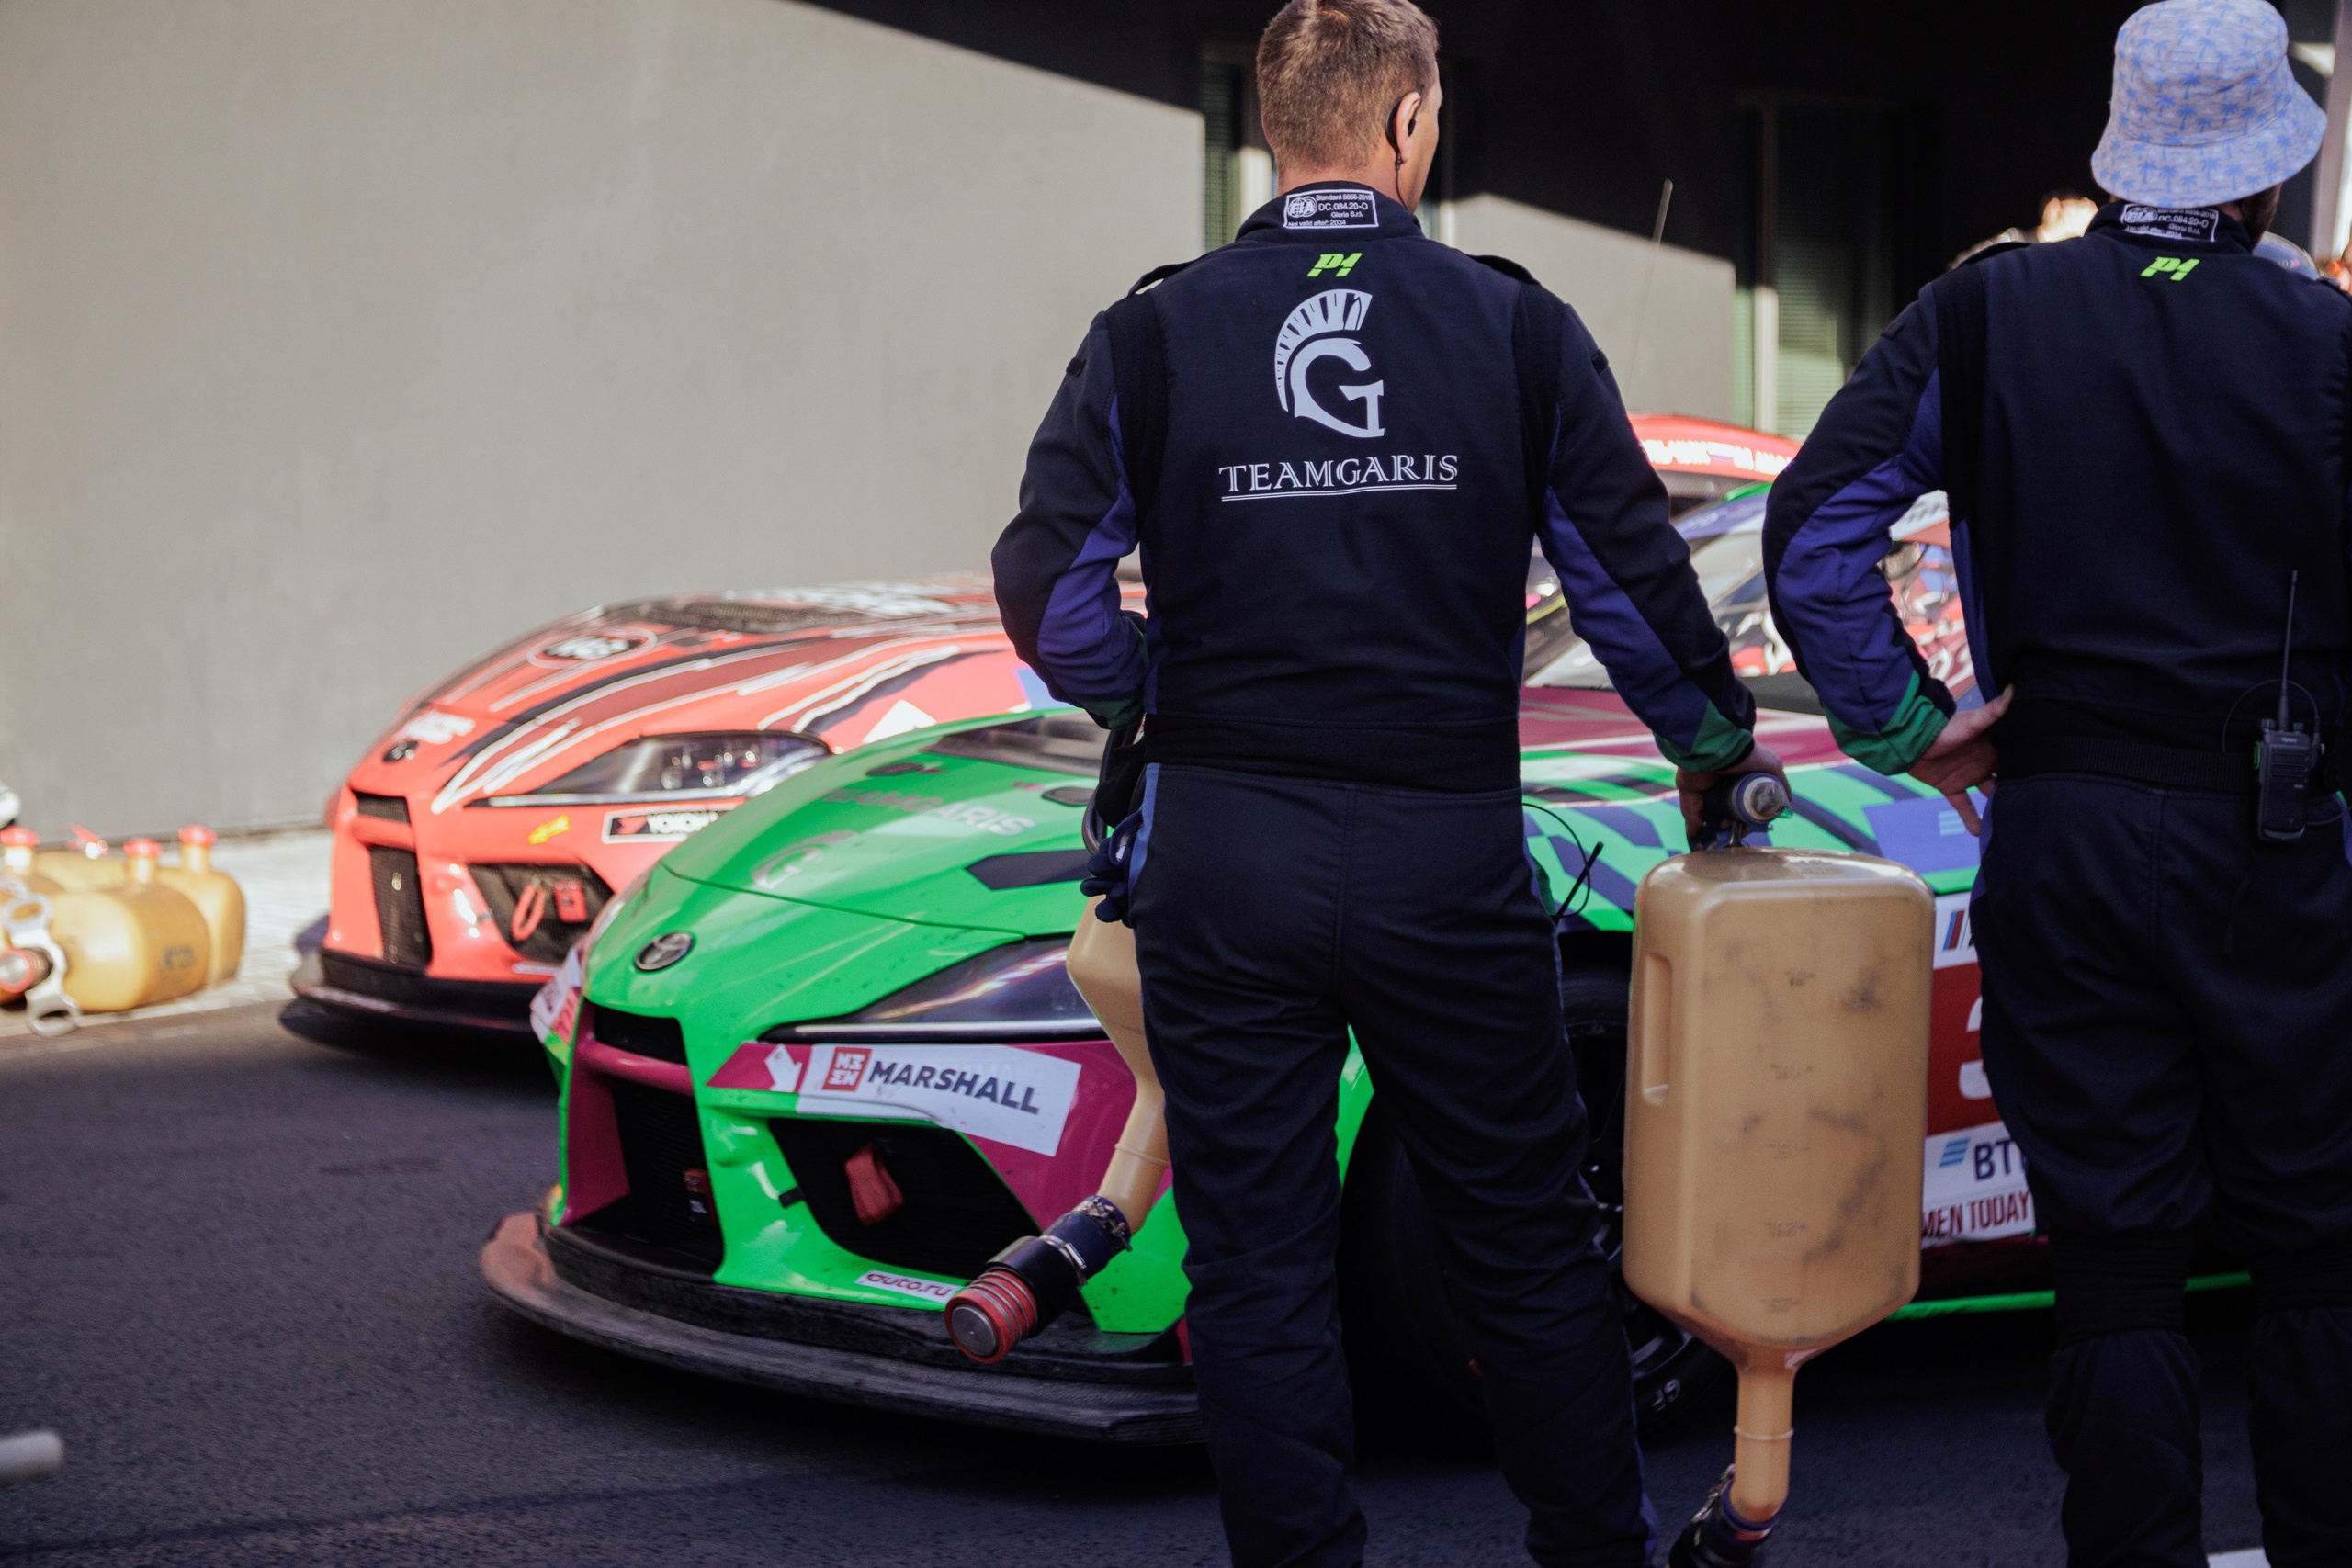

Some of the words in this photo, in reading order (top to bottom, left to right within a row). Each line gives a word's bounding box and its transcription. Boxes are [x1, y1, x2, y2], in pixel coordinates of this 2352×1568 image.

[1219, 454, 1458, 492] TEAMGARIS
[868, 1060, 1040, 1115] MARSHALL
[1969, 1190, 2030, 1233] TODAY
[866, 1273, 952, 1297] auto.ru
